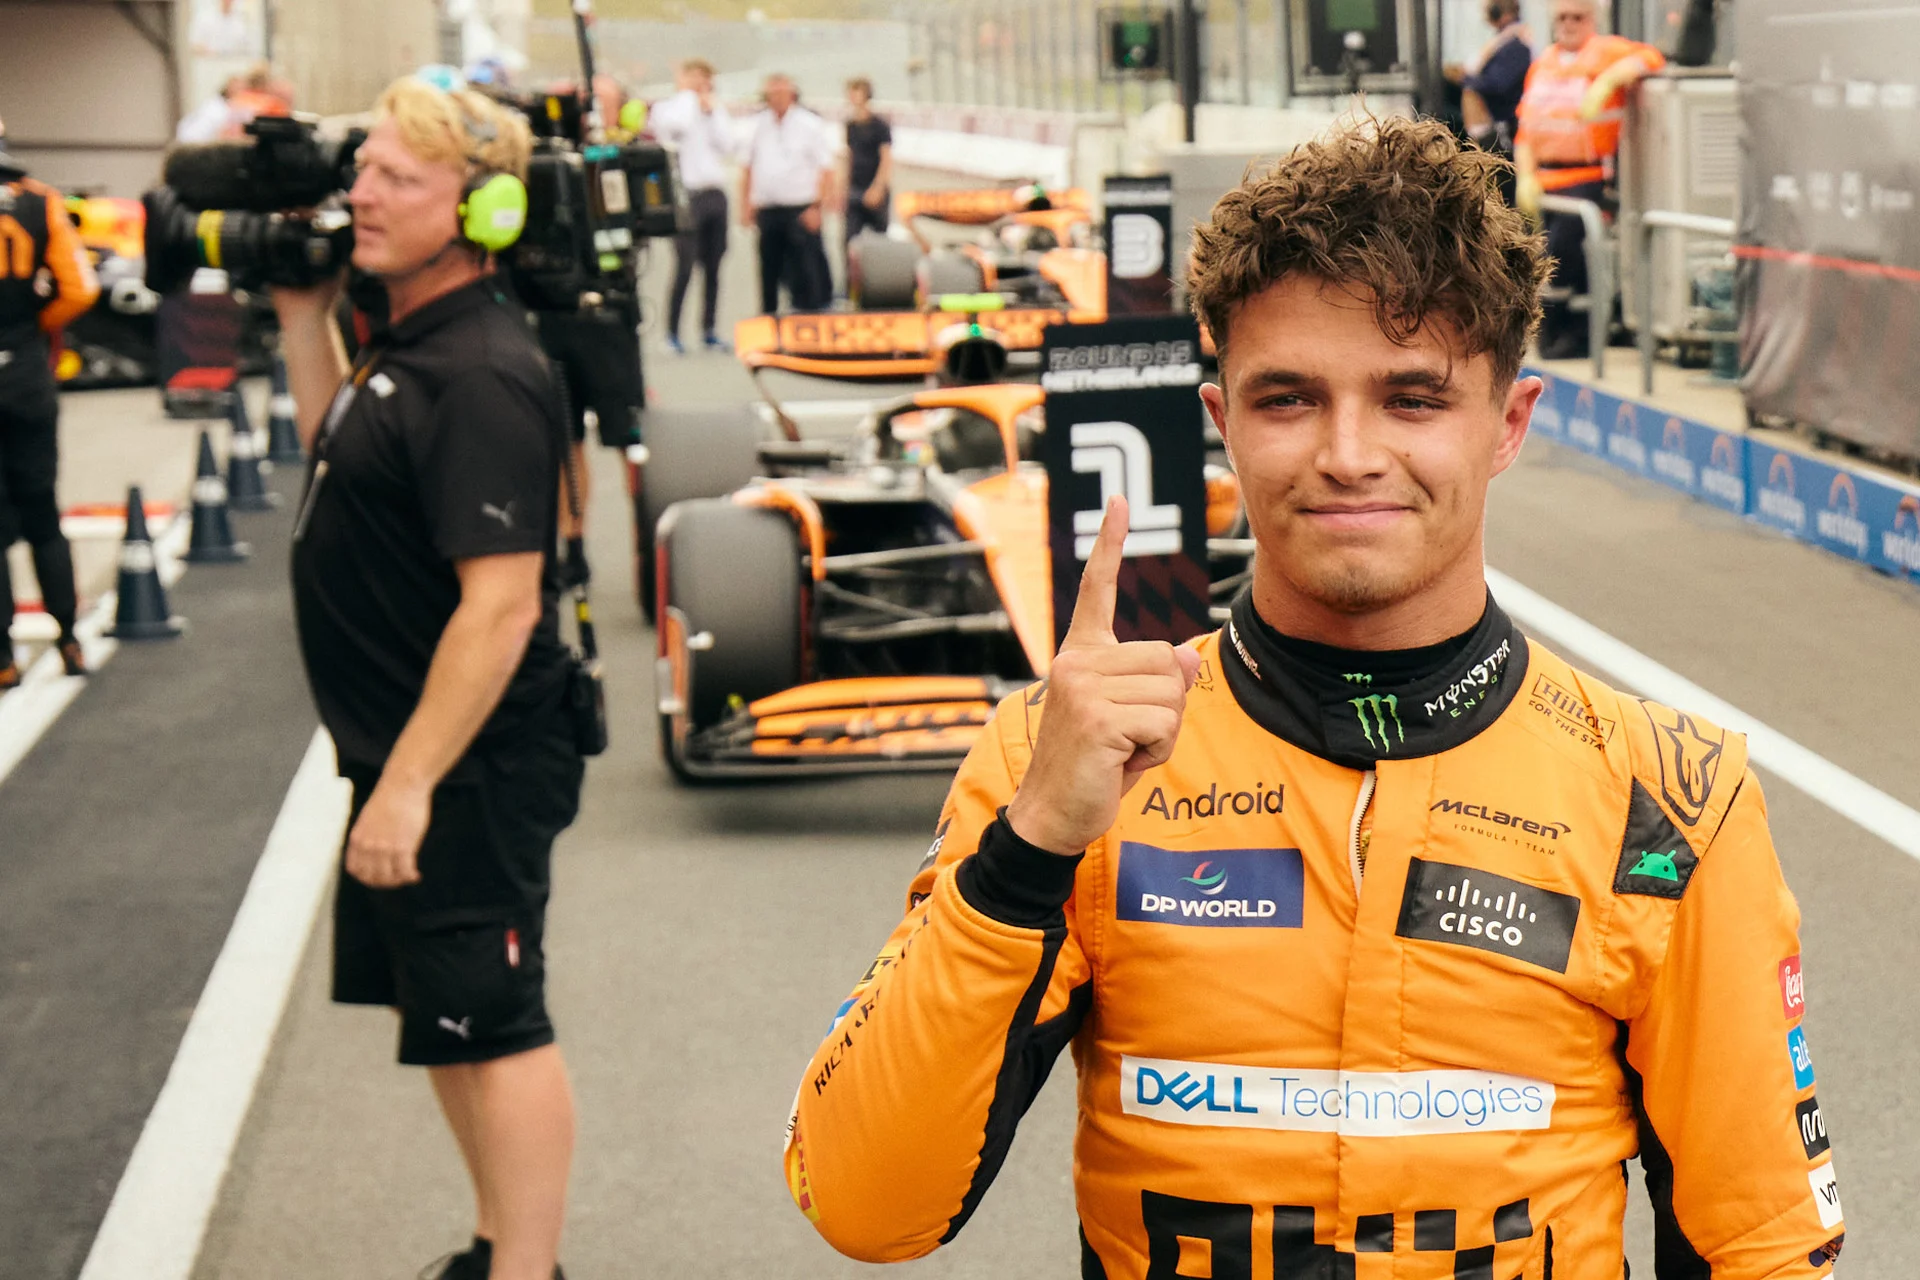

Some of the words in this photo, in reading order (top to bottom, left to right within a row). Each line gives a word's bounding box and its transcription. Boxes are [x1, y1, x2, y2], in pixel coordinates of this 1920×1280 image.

[1070, 421, 1182, 560] 1
[1424, 639, 1511, 717] MONSTER
[1555, 716, 1579, 737] THE
[1141, 782, 1285, 820] Android
[1430, 799, 1572, 840] McLaren
[1454, 823, 1508, 842] FORMULA
[1526, 842, 1556, 856] TEAM
[1141, 893, 1177, 913] DP
[1180, 899, 1277, 918] WORLD
[1439, 912, 1523, 947] CISCO
[1137, 1067, 1258, 1112] DELL
[1269, 1077, 1544, 1127] Technologies
